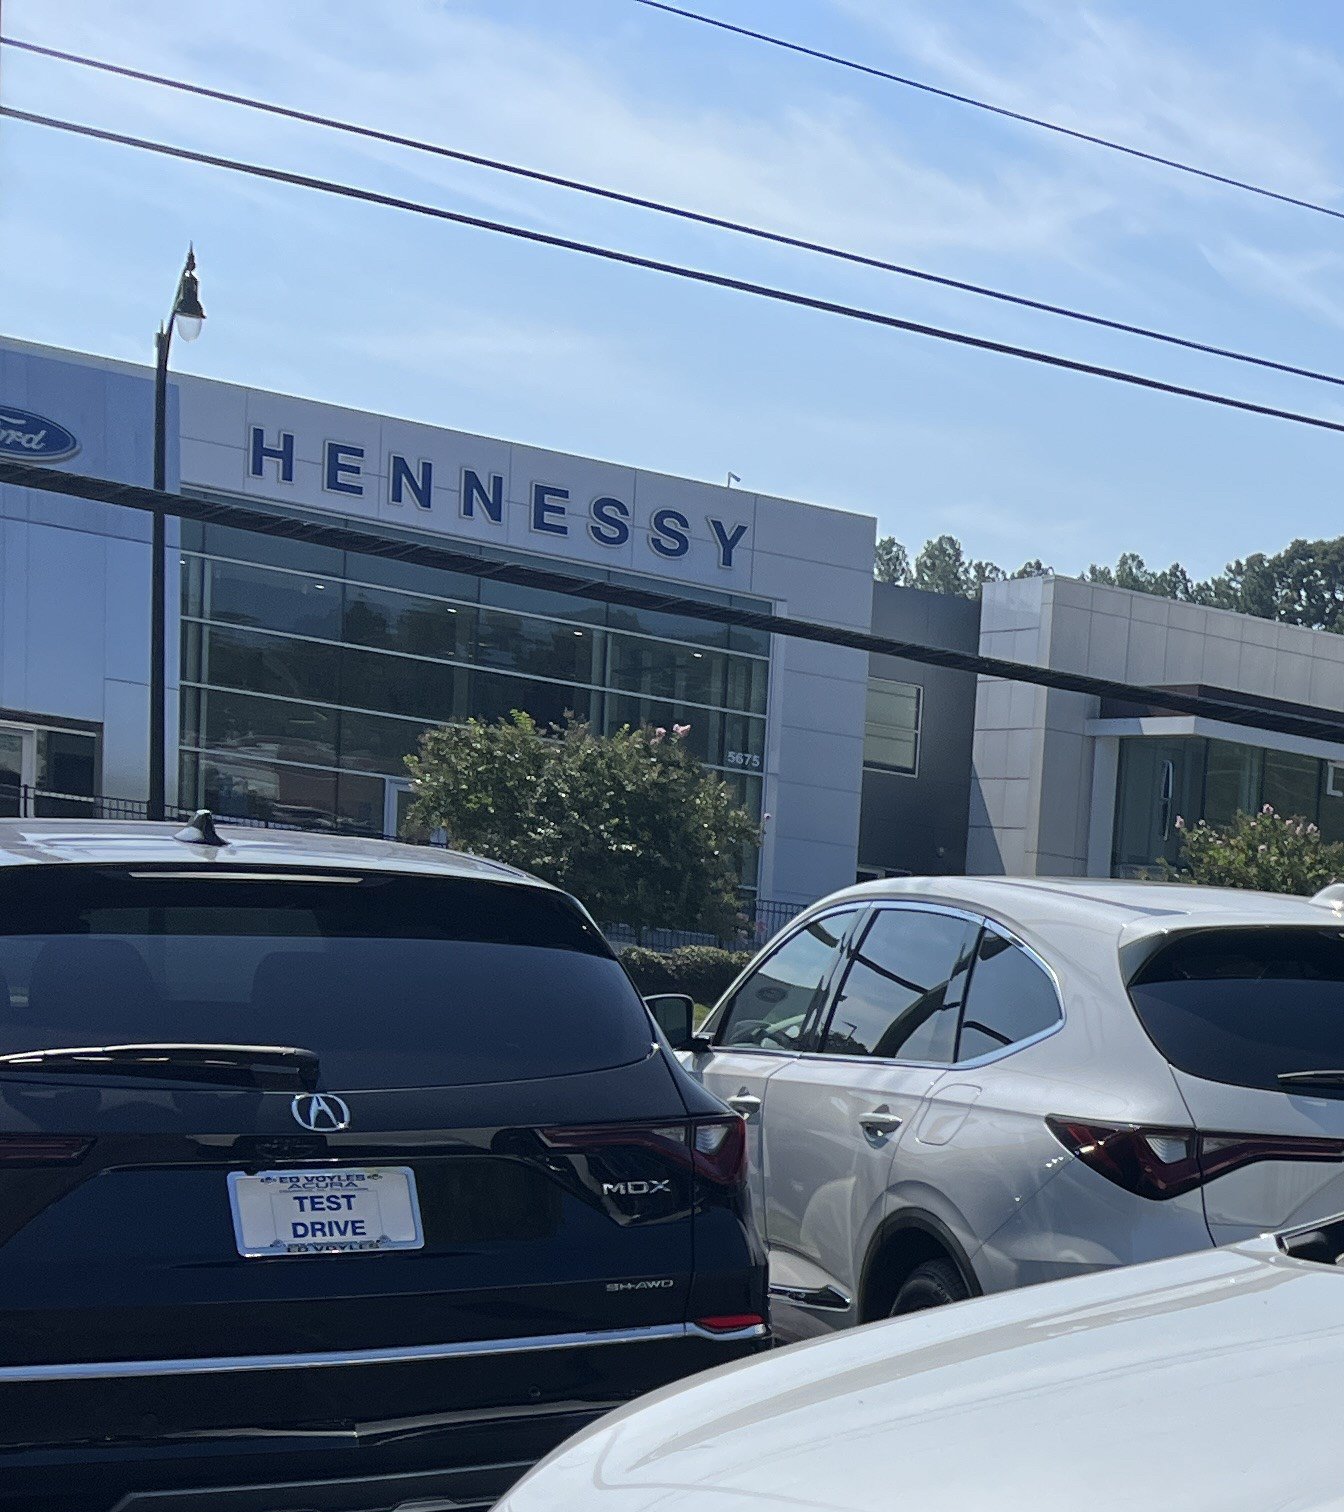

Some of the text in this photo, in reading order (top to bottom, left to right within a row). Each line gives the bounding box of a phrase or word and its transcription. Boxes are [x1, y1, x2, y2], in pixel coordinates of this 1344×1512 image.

[249, 426, 748, 568] HENNESSY
[727, 751, 760, 767] 5675
[279, 1174, 366, 1184] ED VOYLES
[287, 1181, 359, 1190] ACURA
[602, 1180, 671, 1195] MDX
[293, 1194, 357, 1213] TEST
[291, 1220, 367, 1239] DRIVE
